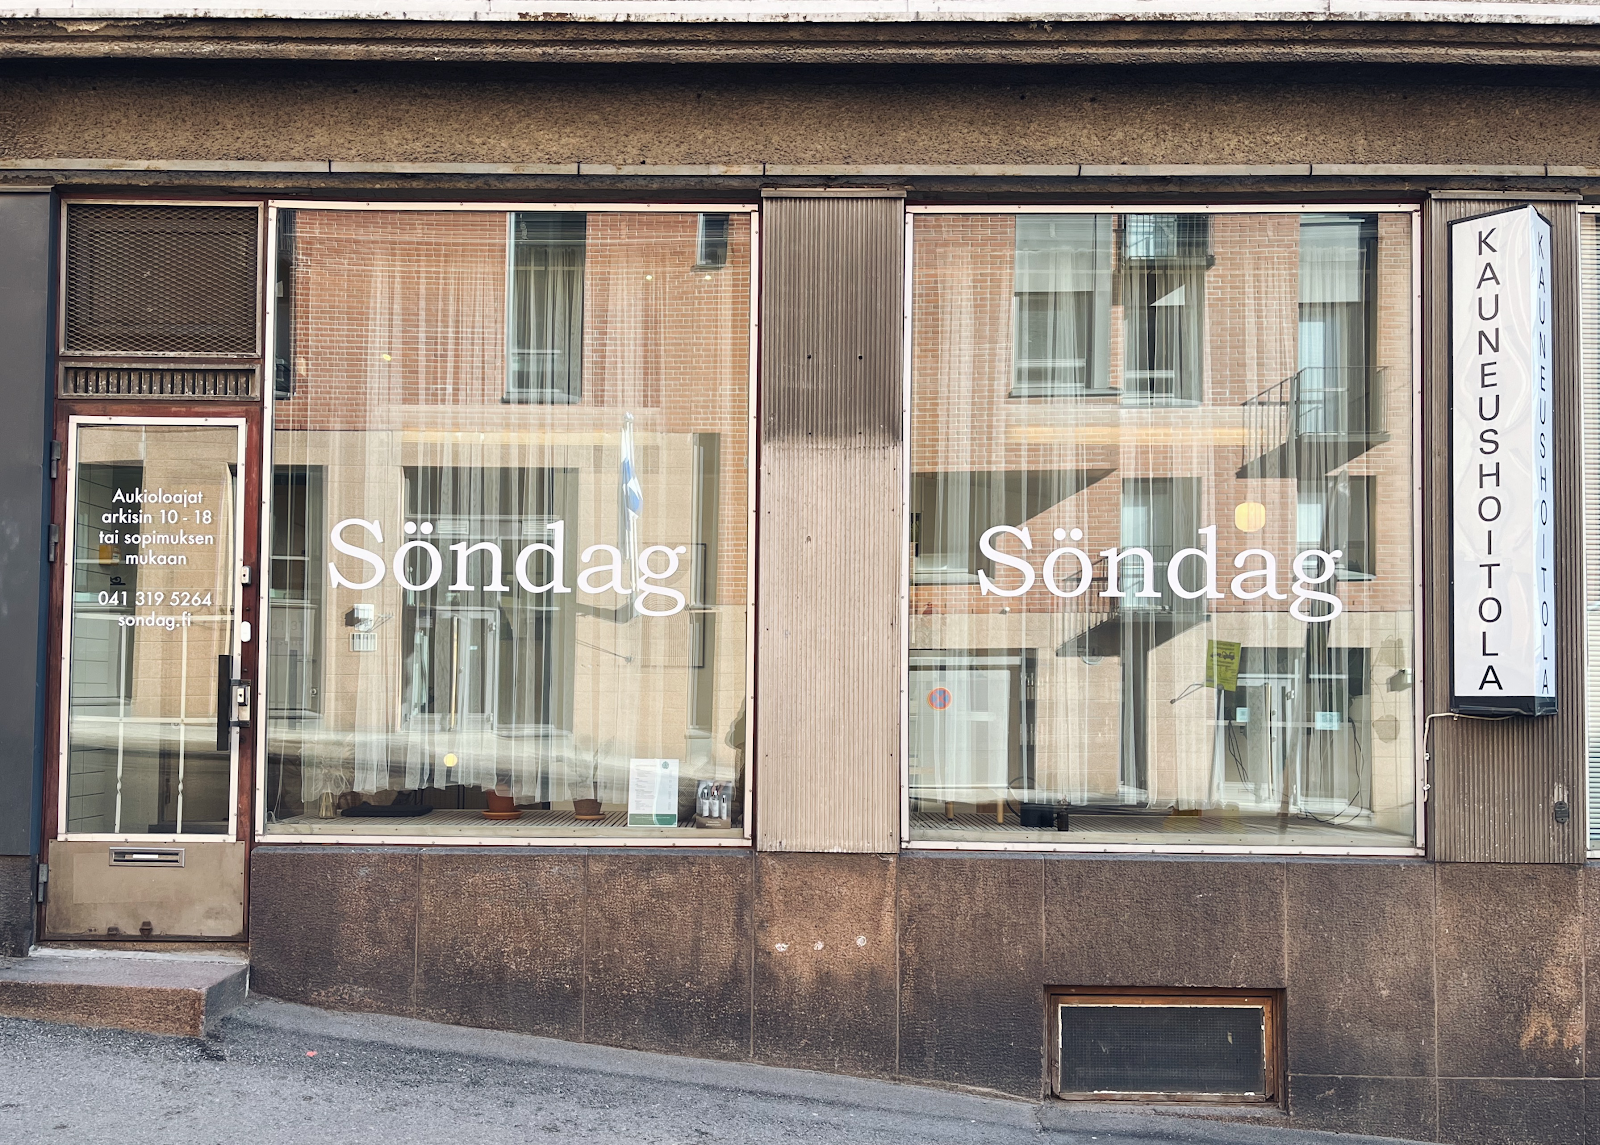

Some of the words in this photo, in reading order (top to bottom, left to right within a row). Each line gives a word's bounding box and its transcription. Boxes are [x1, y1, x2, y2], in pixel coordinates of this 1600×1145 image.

[1476, 227, 1503, 691] KAUNEUSHOITOLA
[1537, 231, 1550, 695] KAUNEUSHOITOLA
[112, 488, 203, 507] Aukioloajat
[101, 508, 152, 524] arkisin
[160, 510, 178, 524] 10
[195, 510, 212, 524] 18
[99, 530, 119, 544] tai
[124, 530, 214, 548] sopimuksen
[125, 550, 187, 565] mukaan
[329, 518, 687, 617] Söndag
[977, 524, 1344, 623] Söndag
[98, 591, 128, 606] 041
[135, 591, 164, 606] 319
[170, 591, 212, 606] 5264
[117, 611, 192, 631] sondag.fi
